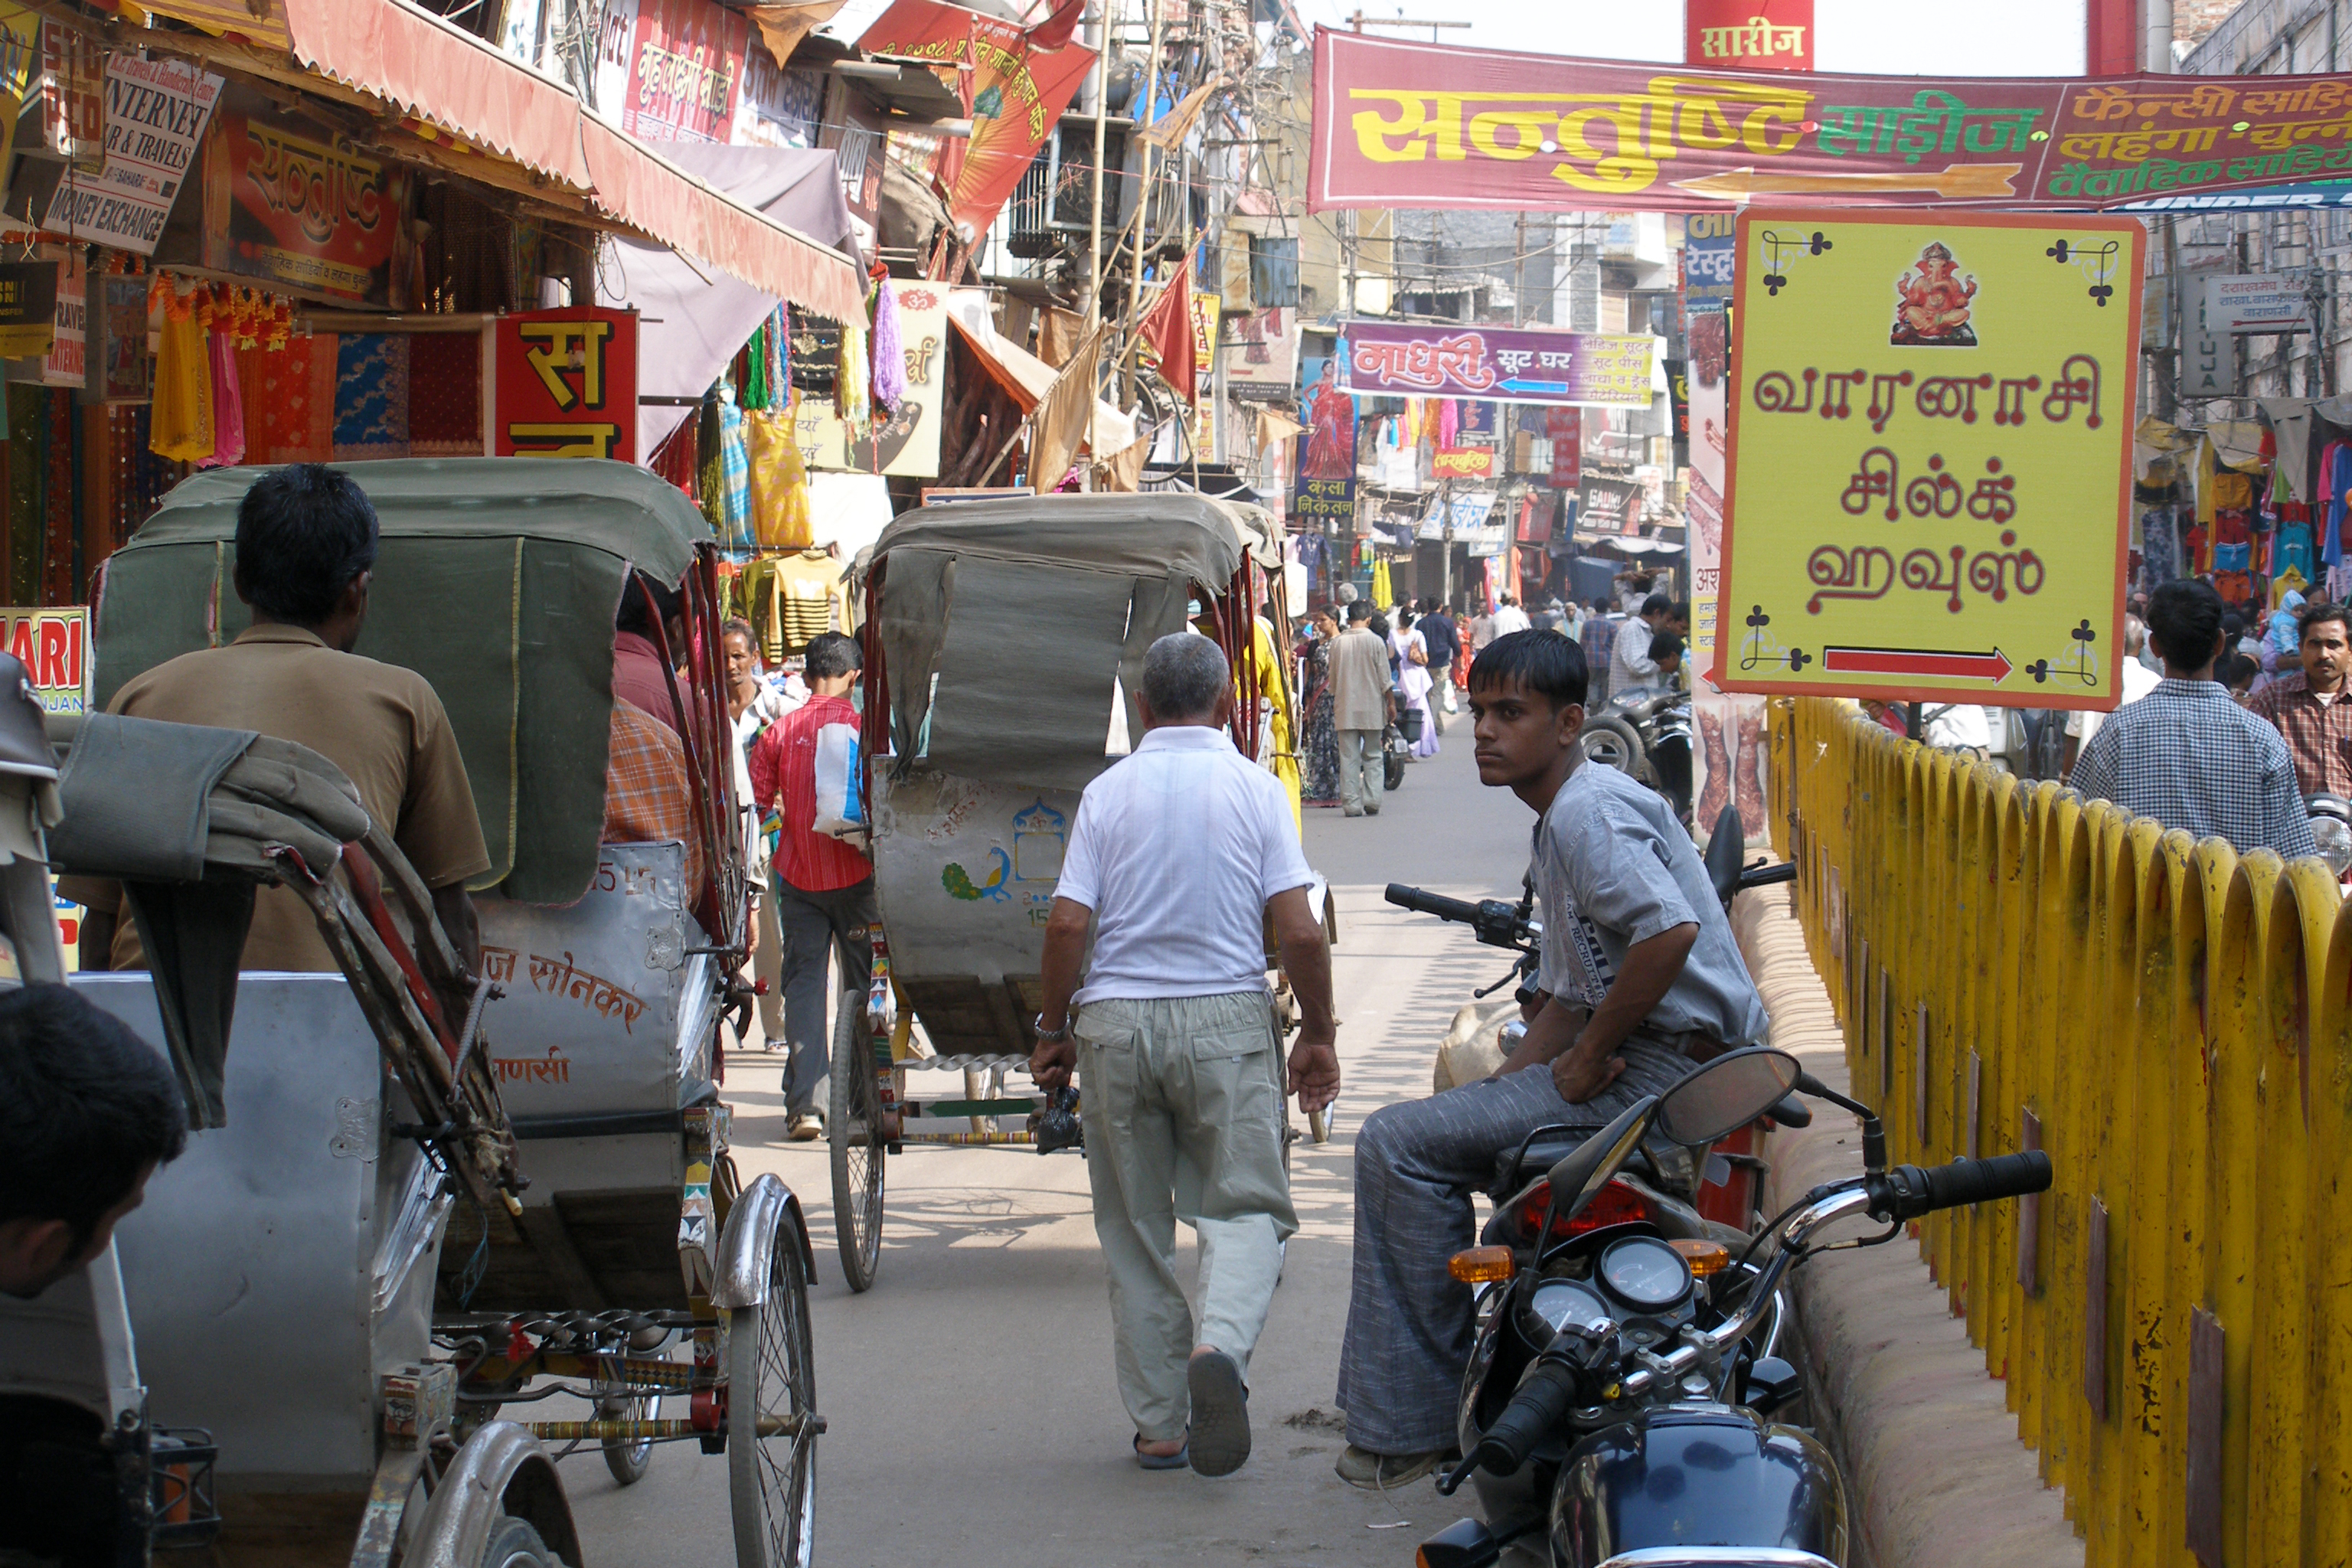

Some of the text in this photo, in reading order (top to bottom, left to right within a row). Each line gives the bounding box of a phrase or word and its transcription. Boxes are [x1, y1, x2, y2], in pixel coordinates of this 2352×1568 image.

[1700, 16, 1806, 57] सारीज
[106, 75, 208, 142] NTERNET
[2242, 80, 2352, 116] साड़ि
[133, 132, 191, 171] TRAVELS
[1349, 75, 2044, 193] सन्तुष्टि साड़ीज
[2226, 141, 2352, 182] साड़िय
[47, 186, 166, 242] MONEY EXCHANGE
[2242, 304, 2292, 318] वाराणसी
[1355, 332, 1573, 390] माधुरी सूट घर
[1592, 357, 1614, 371] सूट
[1753, 353, 2104, 434] வாரனாசி
[1307, 479, 1347, 496] कला
[1840, 444, 2017, 524] சில்க்
[1806, 529, 2046, 616] ஹவுஸ்
[0, 616, 83, 691] ARI
